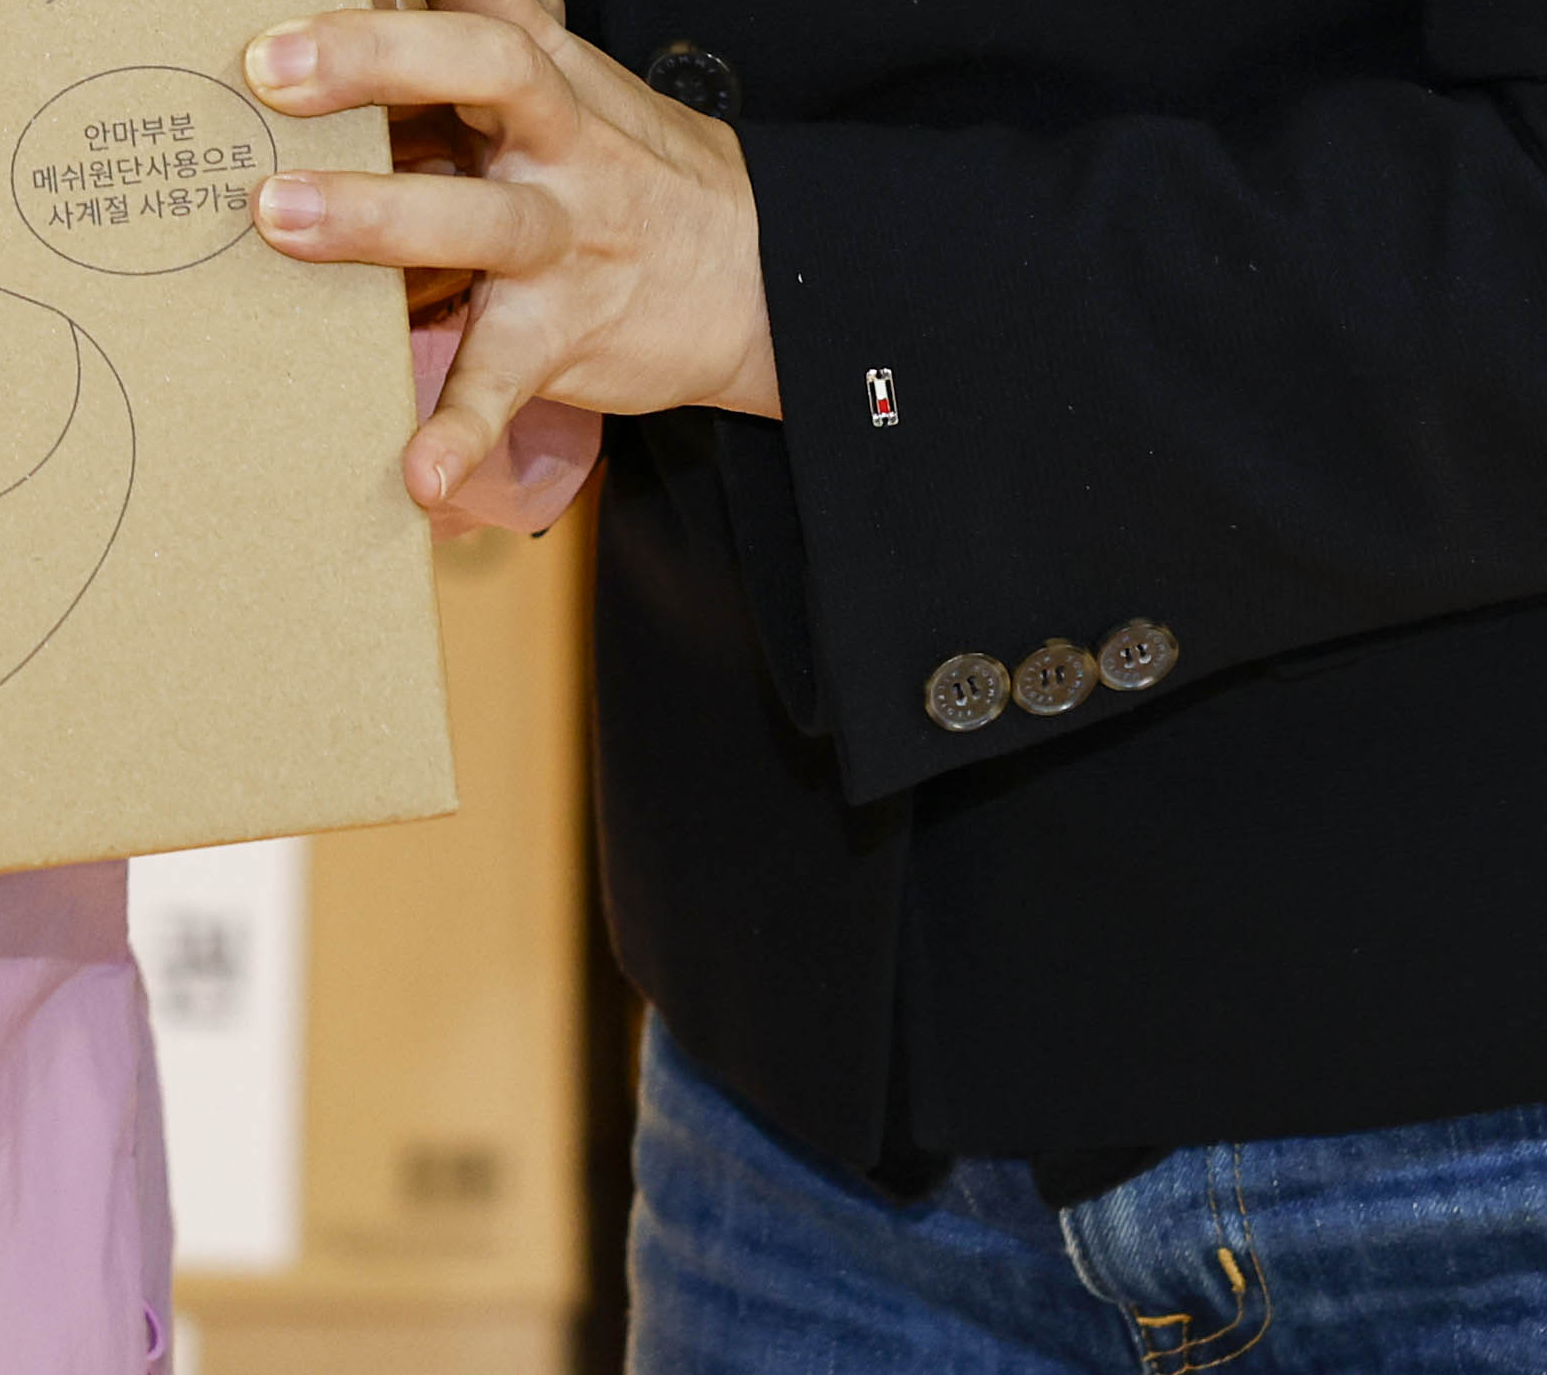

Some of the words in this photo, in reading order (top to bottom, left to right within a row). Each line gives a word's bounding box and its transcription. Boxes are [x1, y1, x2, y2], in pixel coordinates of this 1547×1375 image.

[84, 112, 196, 153] 안마부분
[31, 143, 257, 195] 메쉬원단사용으로
[48, 196, 130, 231] 사계절
[139, 182, 250, 220] 사용가능
